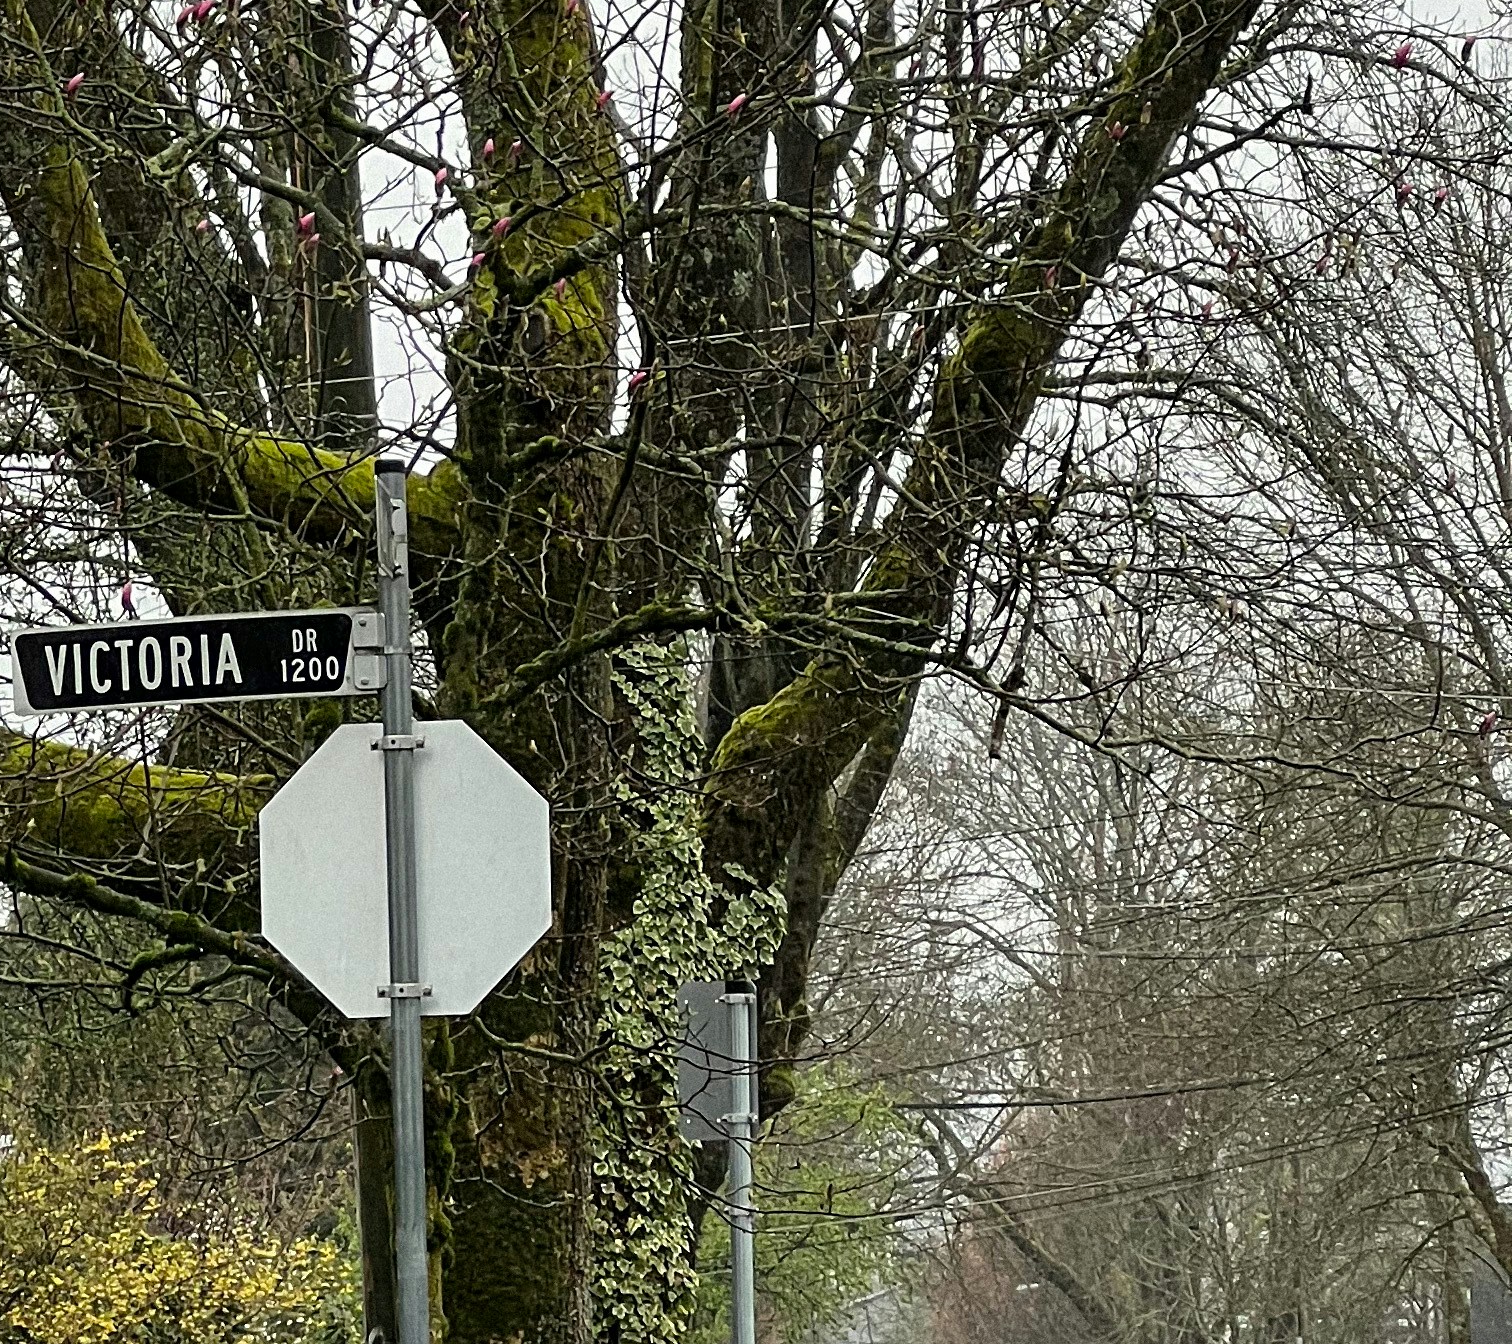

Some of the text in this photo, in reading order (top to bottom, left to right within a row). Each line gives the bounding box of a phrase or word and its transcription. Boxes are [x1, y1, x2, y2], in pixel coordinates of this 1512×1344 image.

[45, 629, 318, 696] VICTORIA DR
[281, 656, 340, 683] 1200
